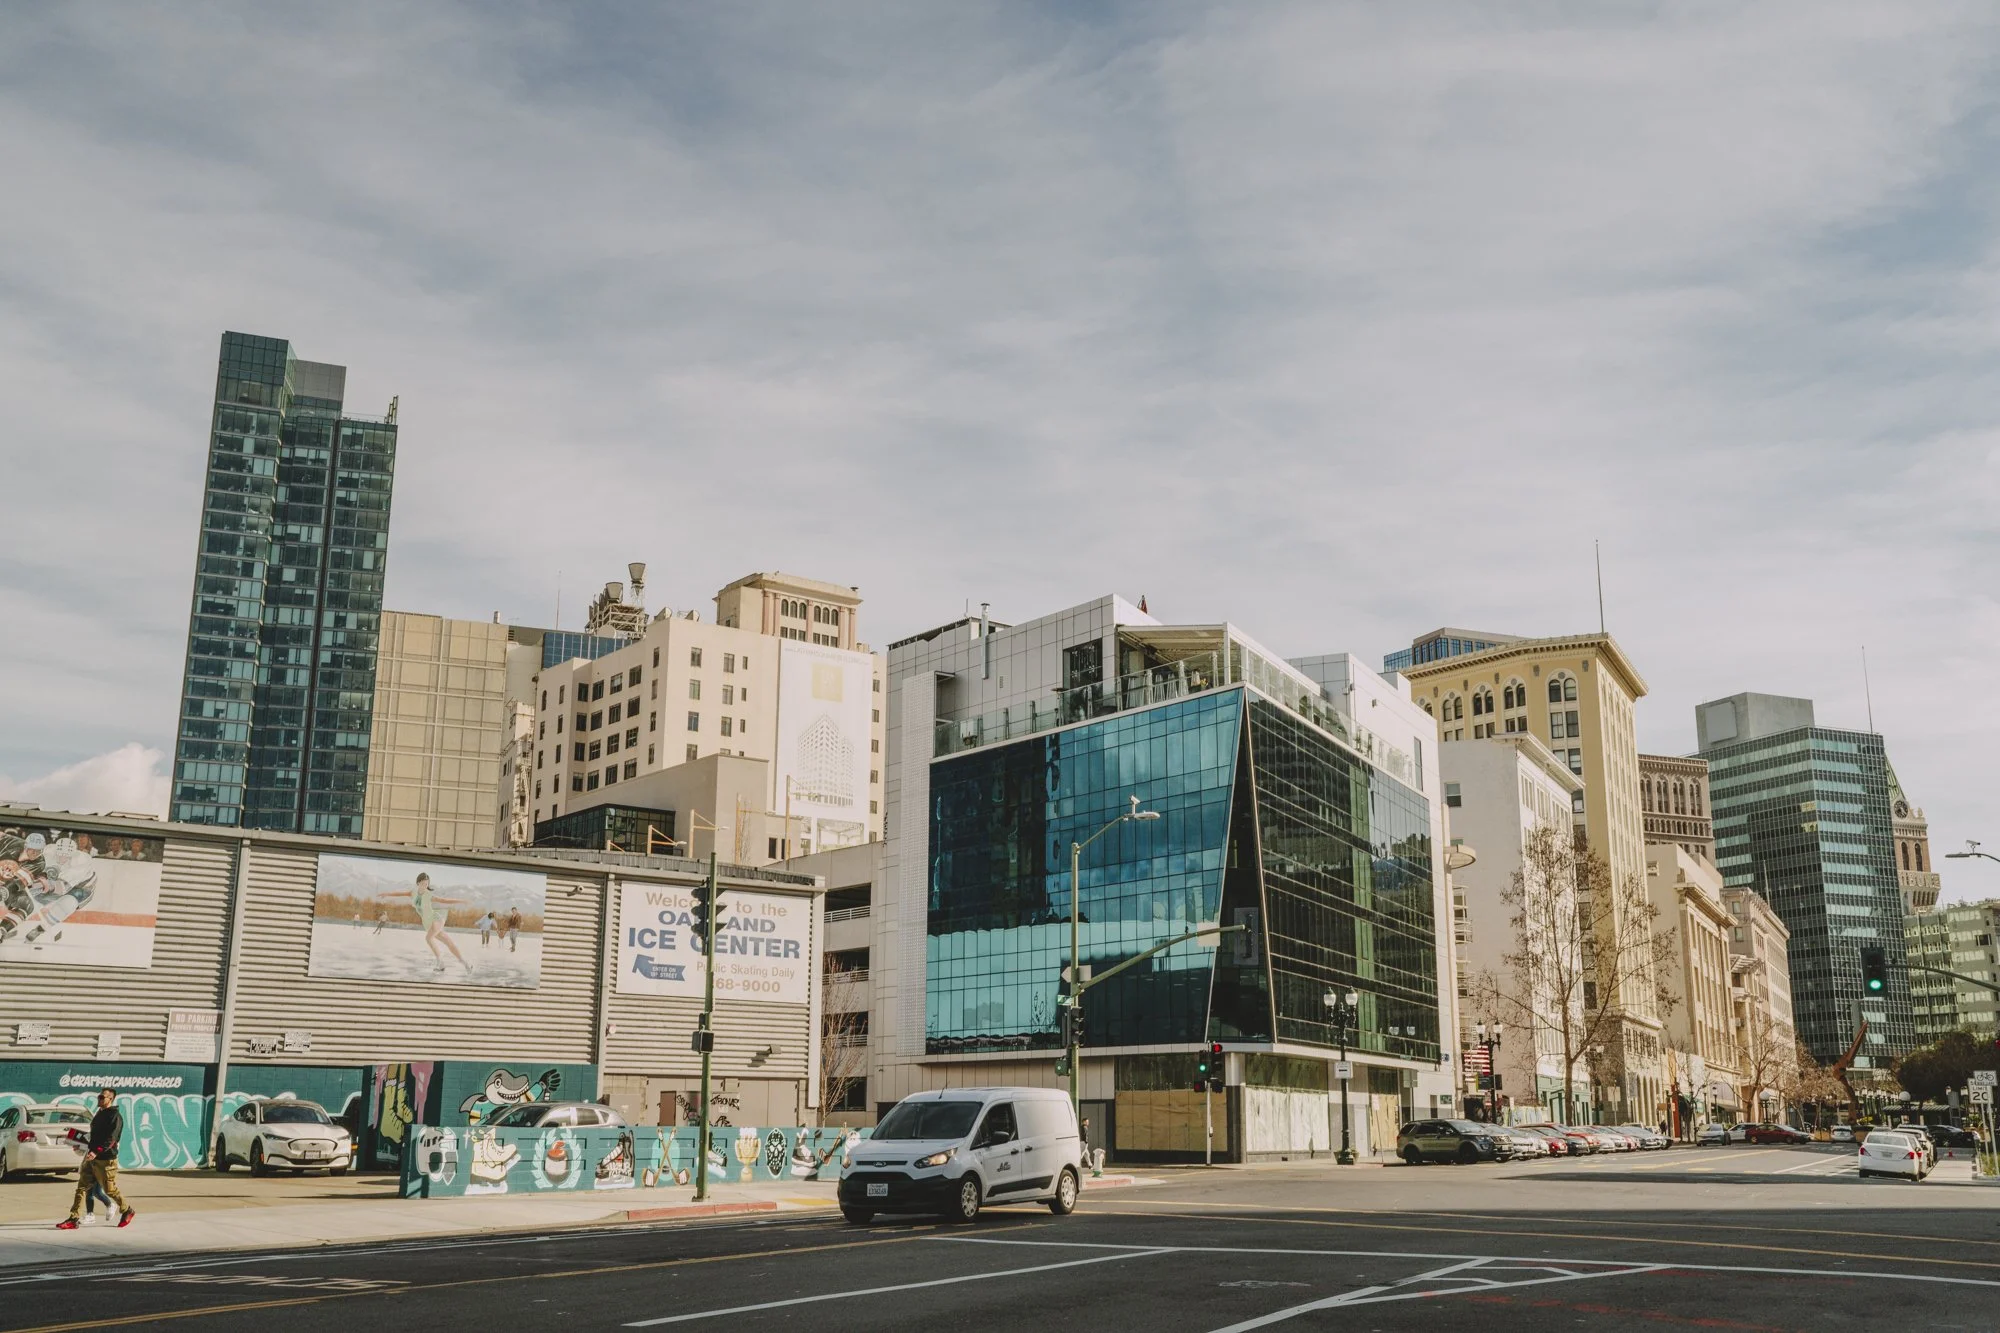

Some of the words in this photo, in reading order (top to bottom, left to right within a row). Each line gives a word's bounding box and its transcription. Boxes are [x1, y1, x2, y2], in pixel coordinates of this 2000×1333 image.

[736, 901, 752, 914] to
[761, 903, 788, 917] the
[658, 910, 776, 933] OAAND
[628, 927, 676, 951] ICE
[731, 964, 768, 977] Skating
[772, 967, 795, 979] Daily
[713, 977, 781, 993] 68-9000
[175, 1013, 186, 1023] NO
[188, 1014, 218, 1025] PARKING
[1972, 1091, 1988, 1101] 20
